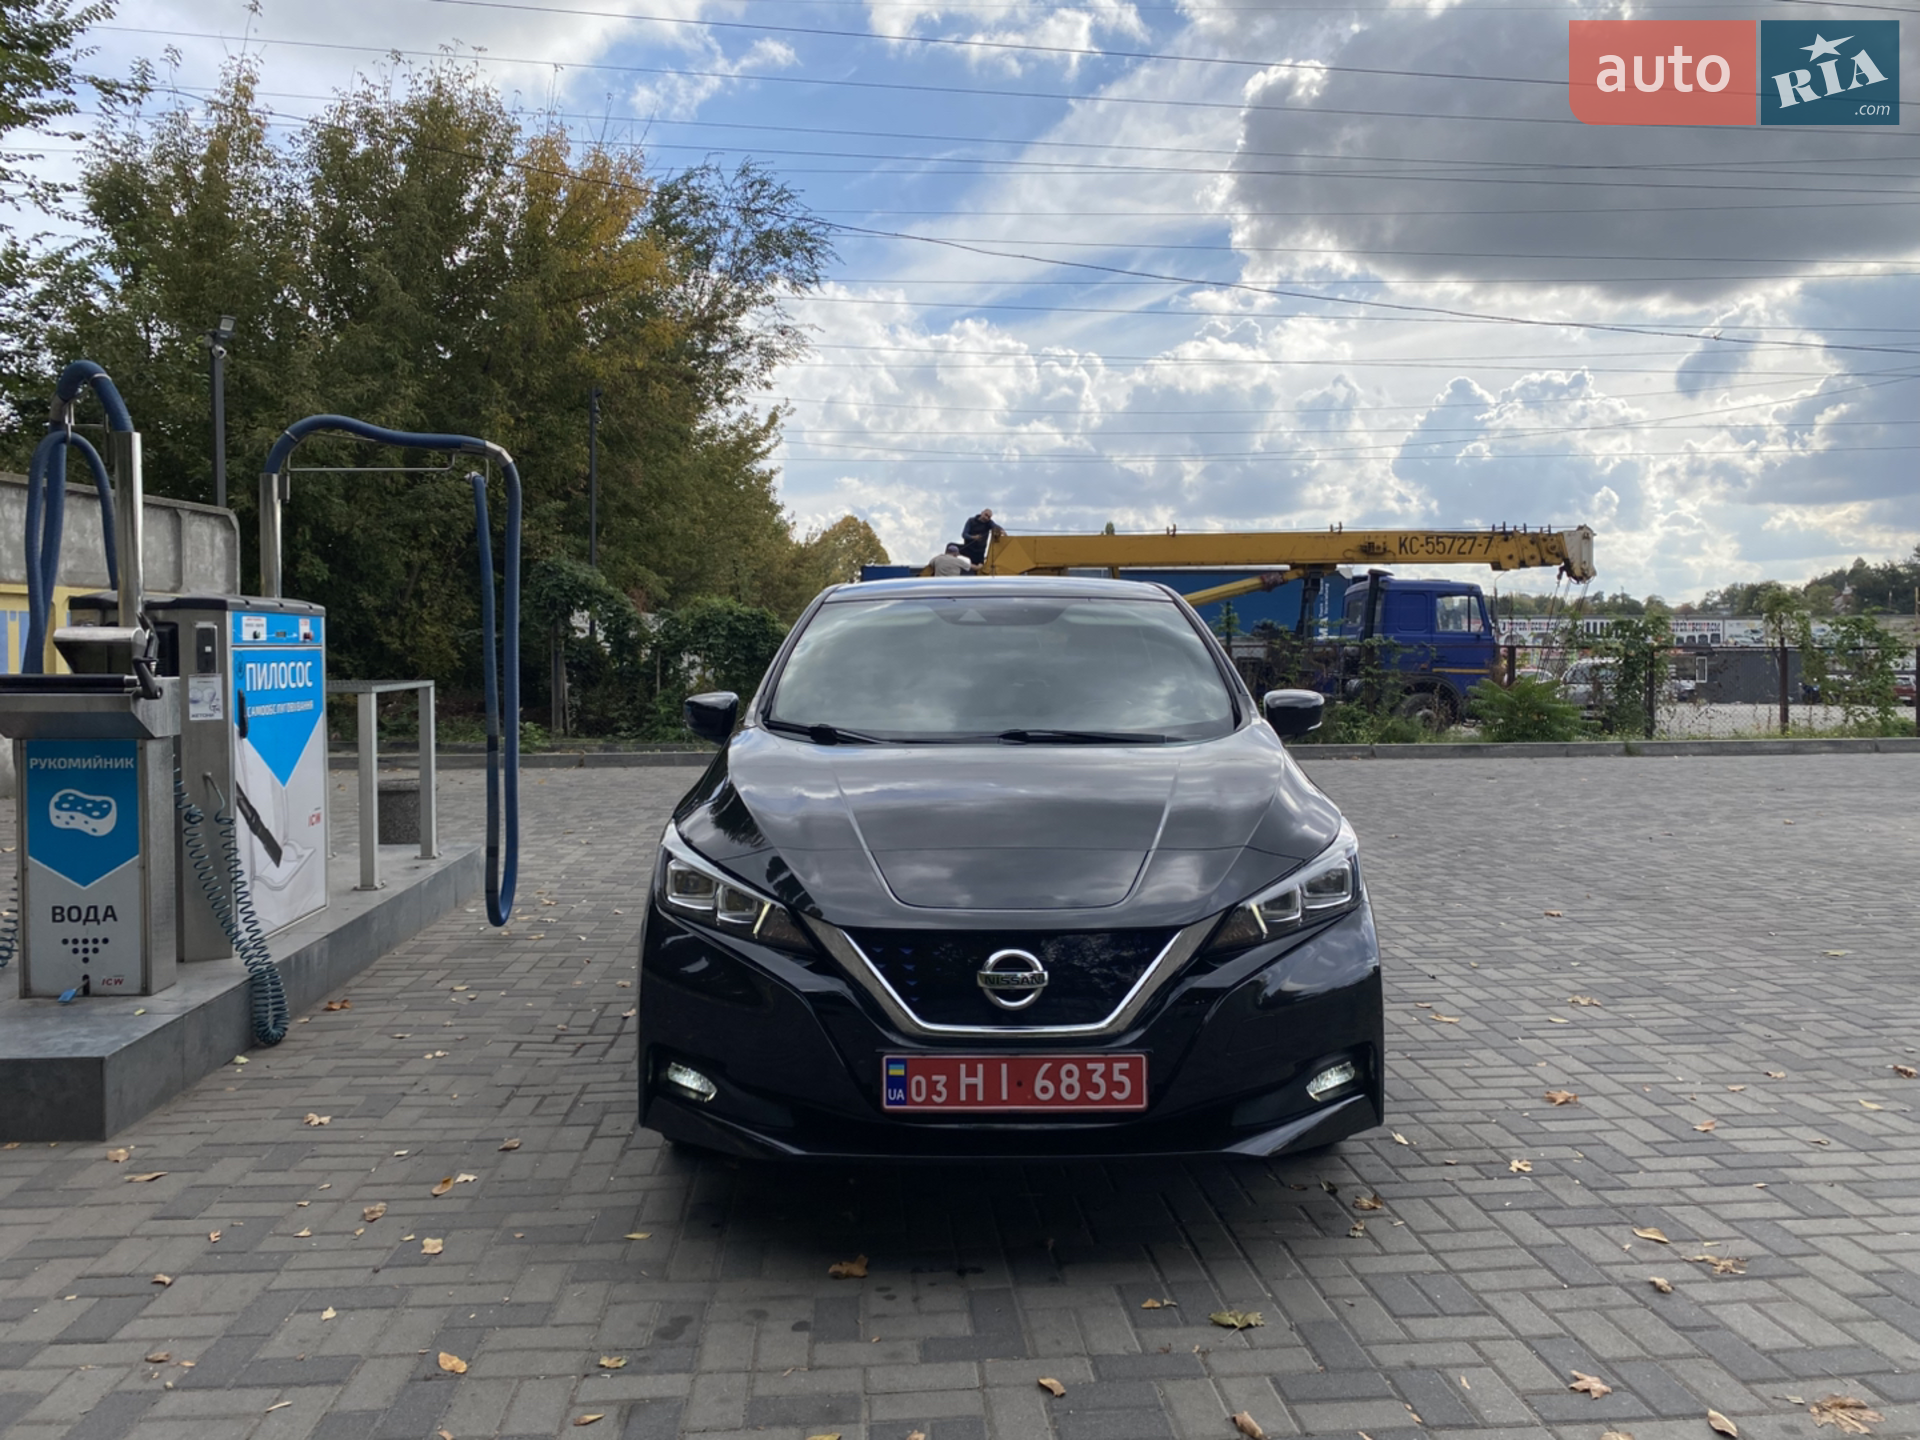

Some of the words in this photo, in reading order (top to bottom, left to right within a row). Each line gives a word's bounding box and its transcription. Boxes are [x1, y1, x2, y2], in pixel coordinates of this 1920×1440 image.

[246, 661, 313, 691] ПИЛОСОС
[29, 755, 135, 770] РУКОМИЙНИК
[52, 905, 118, 926] ВОДА
[102, 978, 125, 986] ICW
[985, 974, 1043, 985] NISSAN
[910, 1075, 948, 1103] 03
[1033, 1062, 1131, 1101] 6835
[888, 1089, 905, 1100] UA
